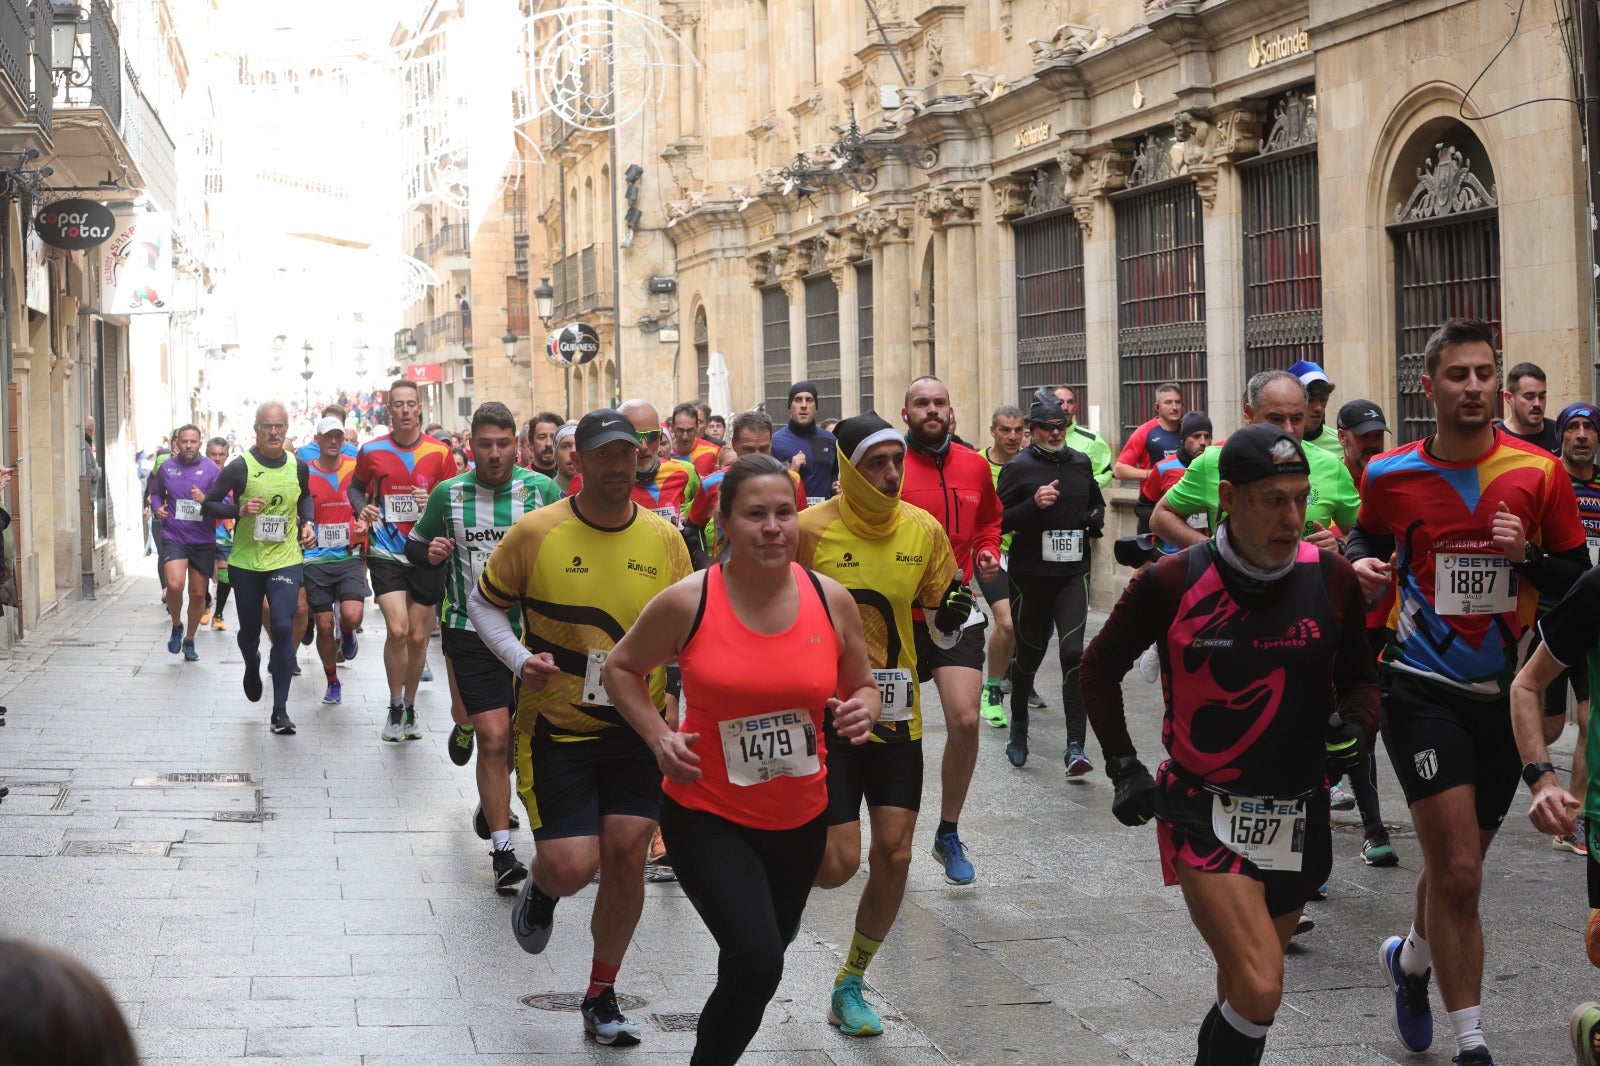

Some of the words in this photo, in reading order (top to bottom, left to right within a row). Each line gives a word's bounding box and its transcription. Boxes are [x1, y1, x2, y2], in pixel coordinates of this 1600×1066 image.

[1260, 27, 1308, 64] Santander
[40, 213, 88, 228] copas
[61, 225, 110, 238] rotas
[560, 341, 597, 352] GUINNESS
[391, 501, 413, 513] 1623
[262, 522, 280, 533] 1317
[324, 530, 340, 540] 1916
[465, 529, 507, 541] betw
[1052, 538, 1072, 551] 1166
[1458, 557, 1512, 567] SETEL
[1450, 570, 1497, 594] 1887
[745, 713, 801, 732] SETEL
[740, 728, 793, 763] 1479
[1241, 801, 1297, 815] SETEL
[1230, 815, 1281, 845] 1587
